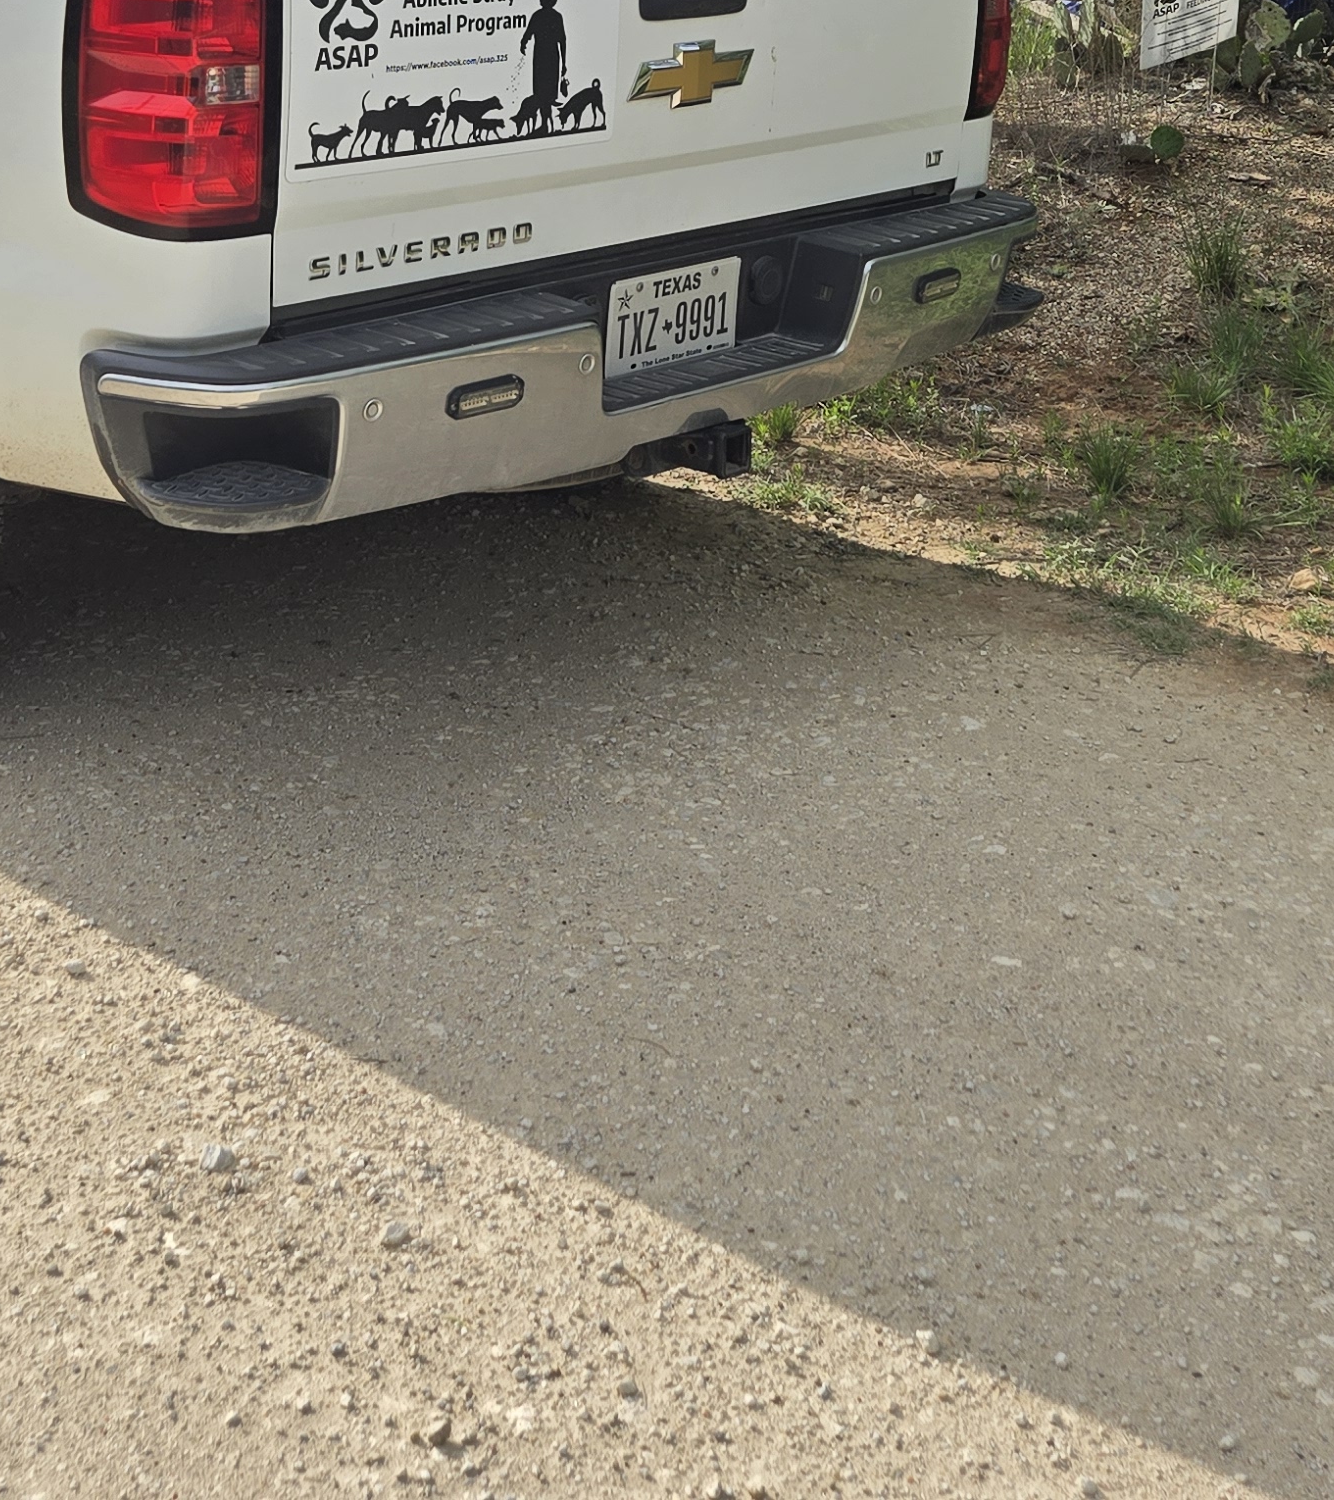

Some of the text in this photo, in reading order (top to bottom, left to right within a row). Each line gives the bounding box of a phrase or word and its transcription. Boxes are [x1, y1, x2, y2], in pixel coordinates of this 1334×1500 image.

[1152, 2, 1180, 19] ASAP
[390, 11, 527, 38] Animal Program
[314, 43, 379, 71] ASAP
[926, 150, 944, 168] LT
[308, 222, 533, 281] SILVERADO
[653, 272, 702, 298] TEXAS
[617, 291, 728, 360] TXZ 9991
